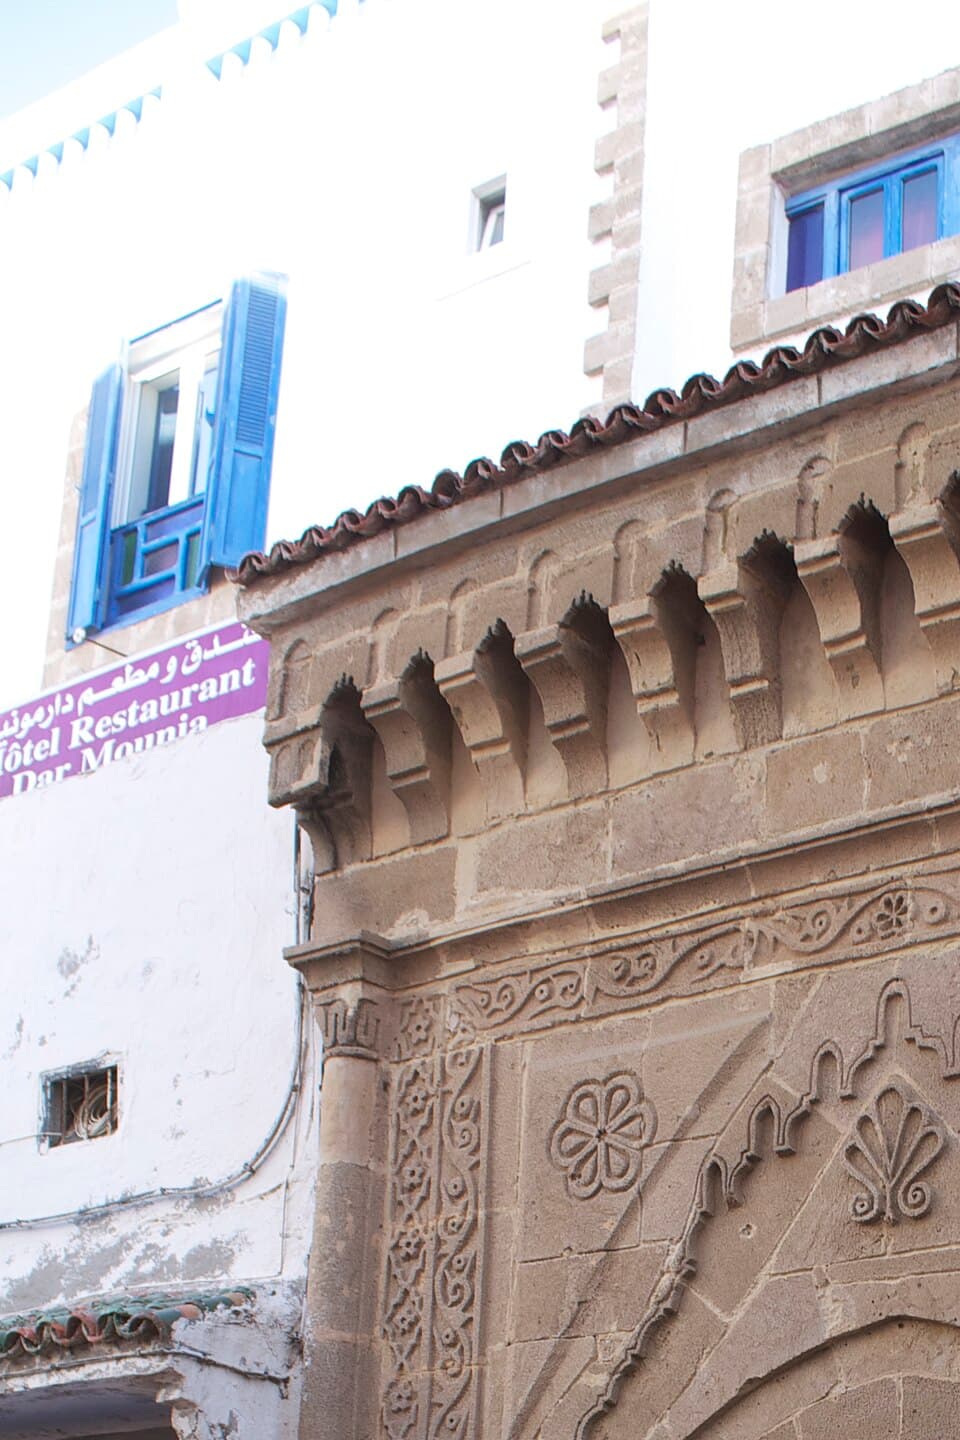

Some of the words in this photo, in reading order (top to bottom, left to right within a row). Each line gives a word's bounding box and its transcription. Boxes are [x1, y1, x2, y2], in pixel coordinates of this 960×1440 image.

[67, 658, 255, 751] Restaurant
[77, 661, 160, 717] مطعم
[159, 656, 178, 684] و
[12, 763, 72, 796] Dar
[80, 713, 208, 774] Mounia
